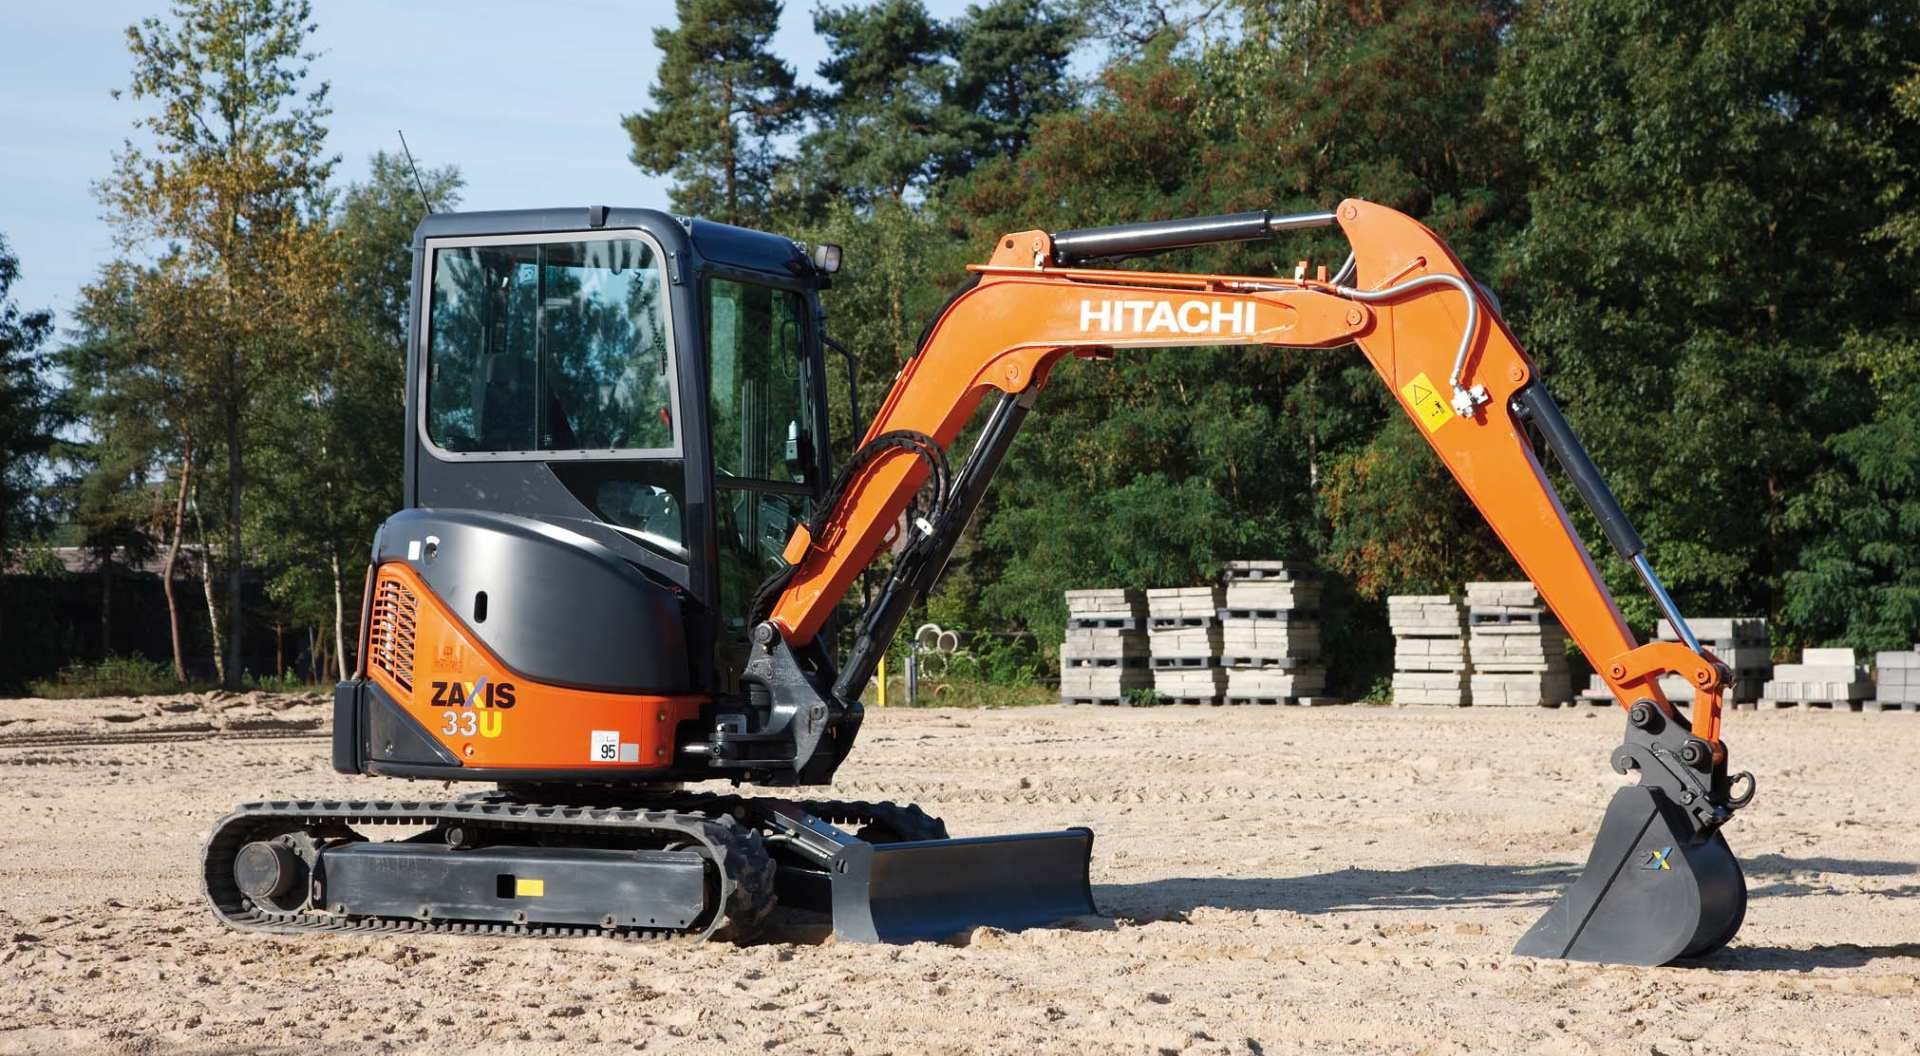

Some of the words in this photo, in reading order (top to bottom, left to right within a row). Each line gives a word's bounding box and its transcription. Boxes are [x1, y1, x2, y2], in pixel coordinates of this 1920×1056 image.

[1080, 300, 1256, 335] HITACHI
[431, 676, 516, 709] ZAXIS
[442, 710, 502, 738] 33U
[601, 744, 616, 759] 95
